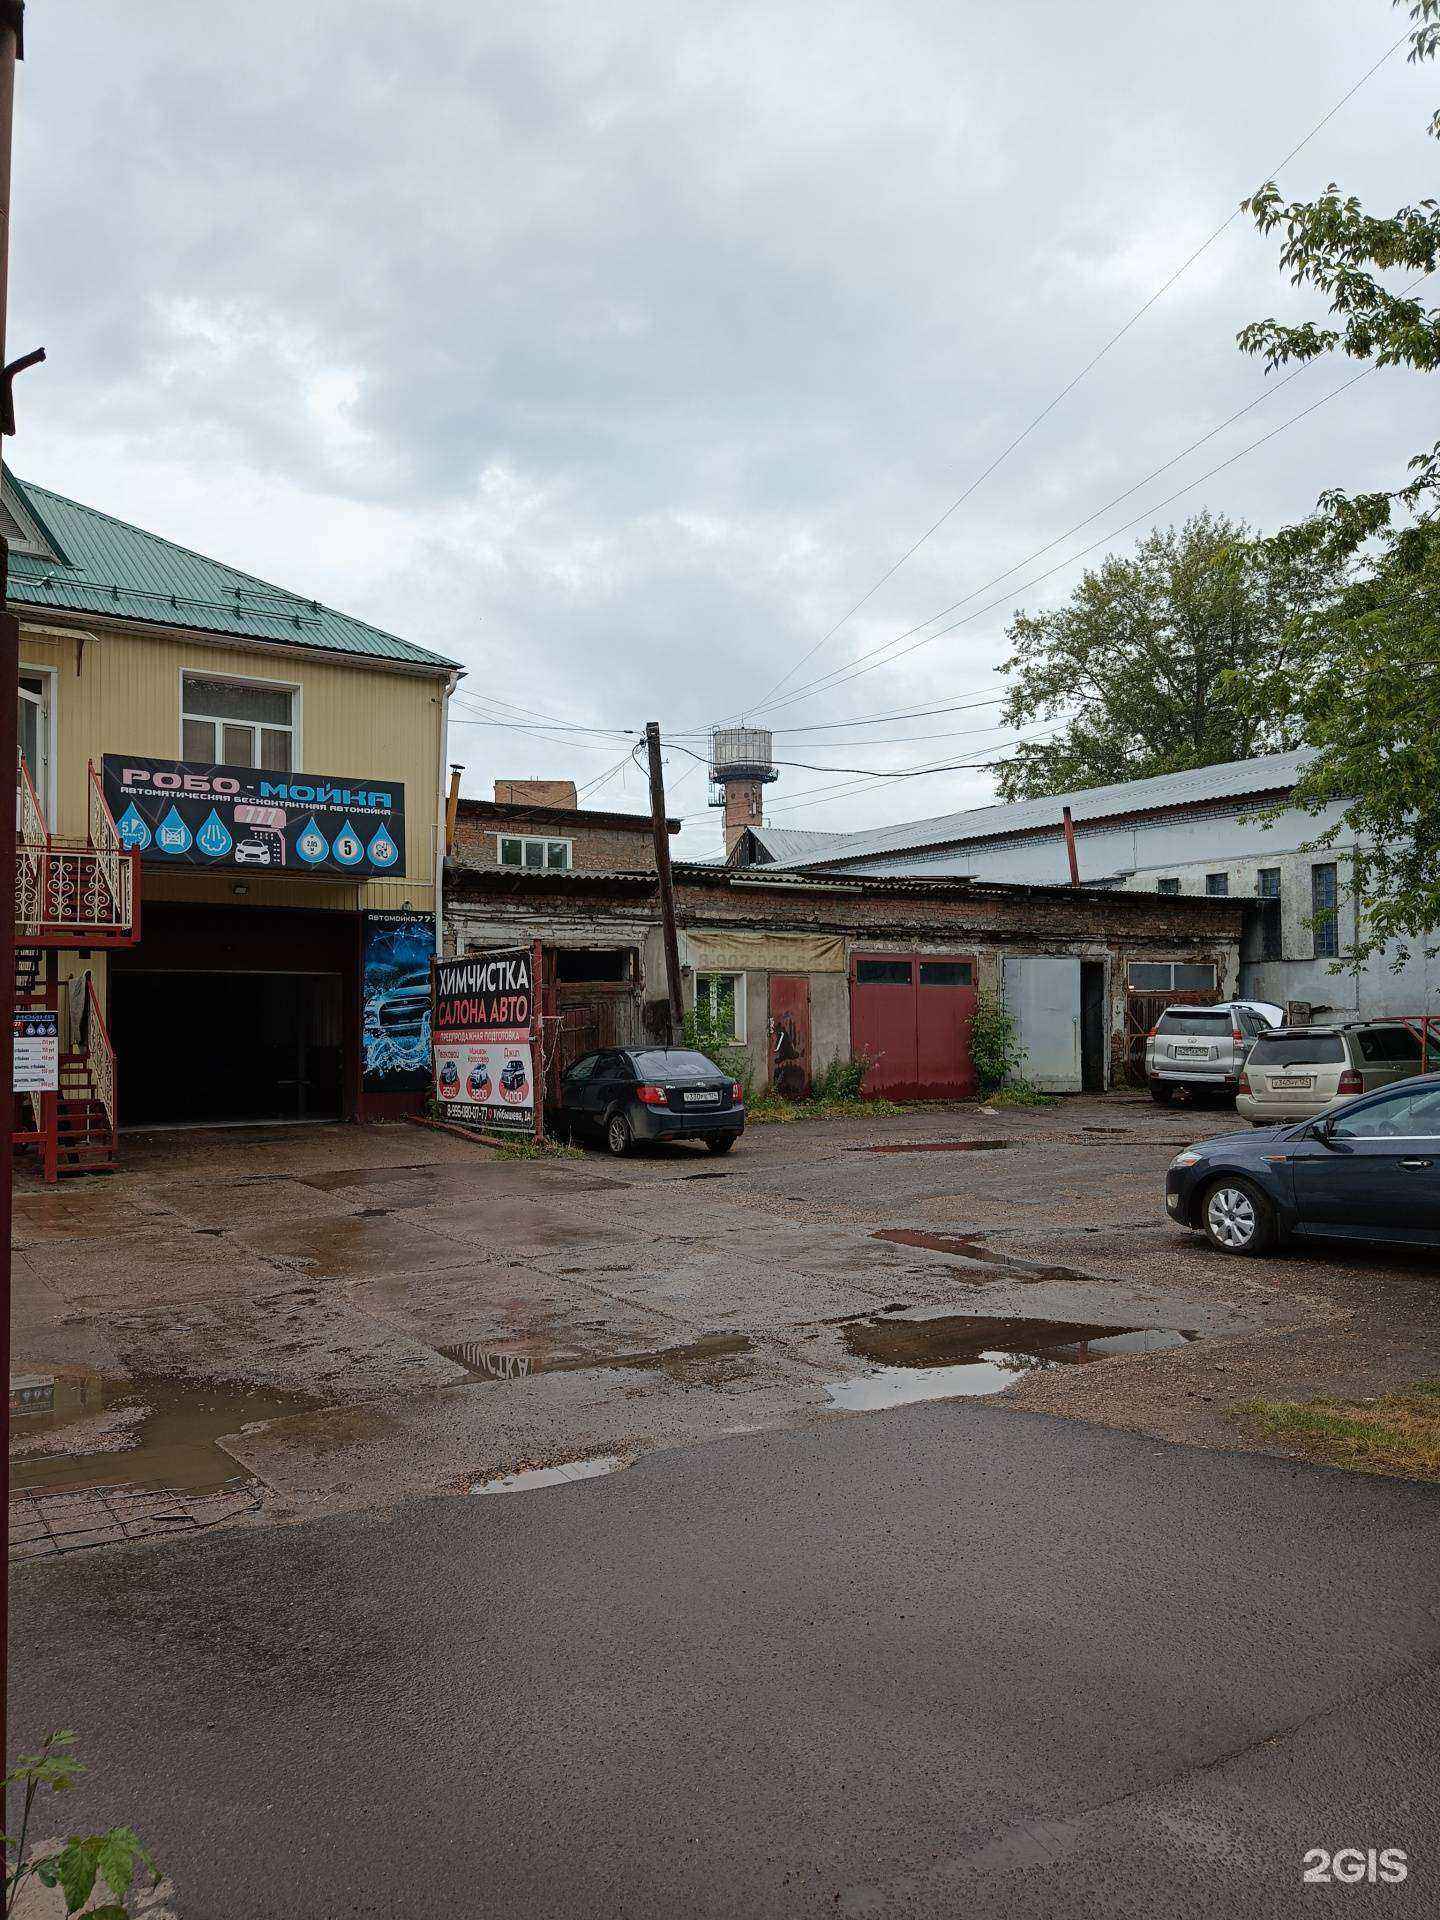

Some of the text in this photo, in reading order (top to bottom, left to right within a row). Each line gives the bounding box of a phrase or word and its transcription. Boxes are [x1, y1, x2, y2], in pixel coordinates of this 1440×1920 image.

[120, 786, 393, 816] АВТОМАТИЧЕСКАЯ БЕСКОНТАКТНАЯ АВТОМОЙКА
[122, 768, 241, 794] РОБО
[260, 781, 392, 808] МОЙКА
[439, 959, 530, 996] ХИМЧИСТКА
[438, 995, 528, 1025] САЛОНА АВТО
[440, 1030, 520, 1043] ПРЕДПРОДАЖНАЯ ПОДГОТОВКА
[504, 1091, 523, 1103] 4000
